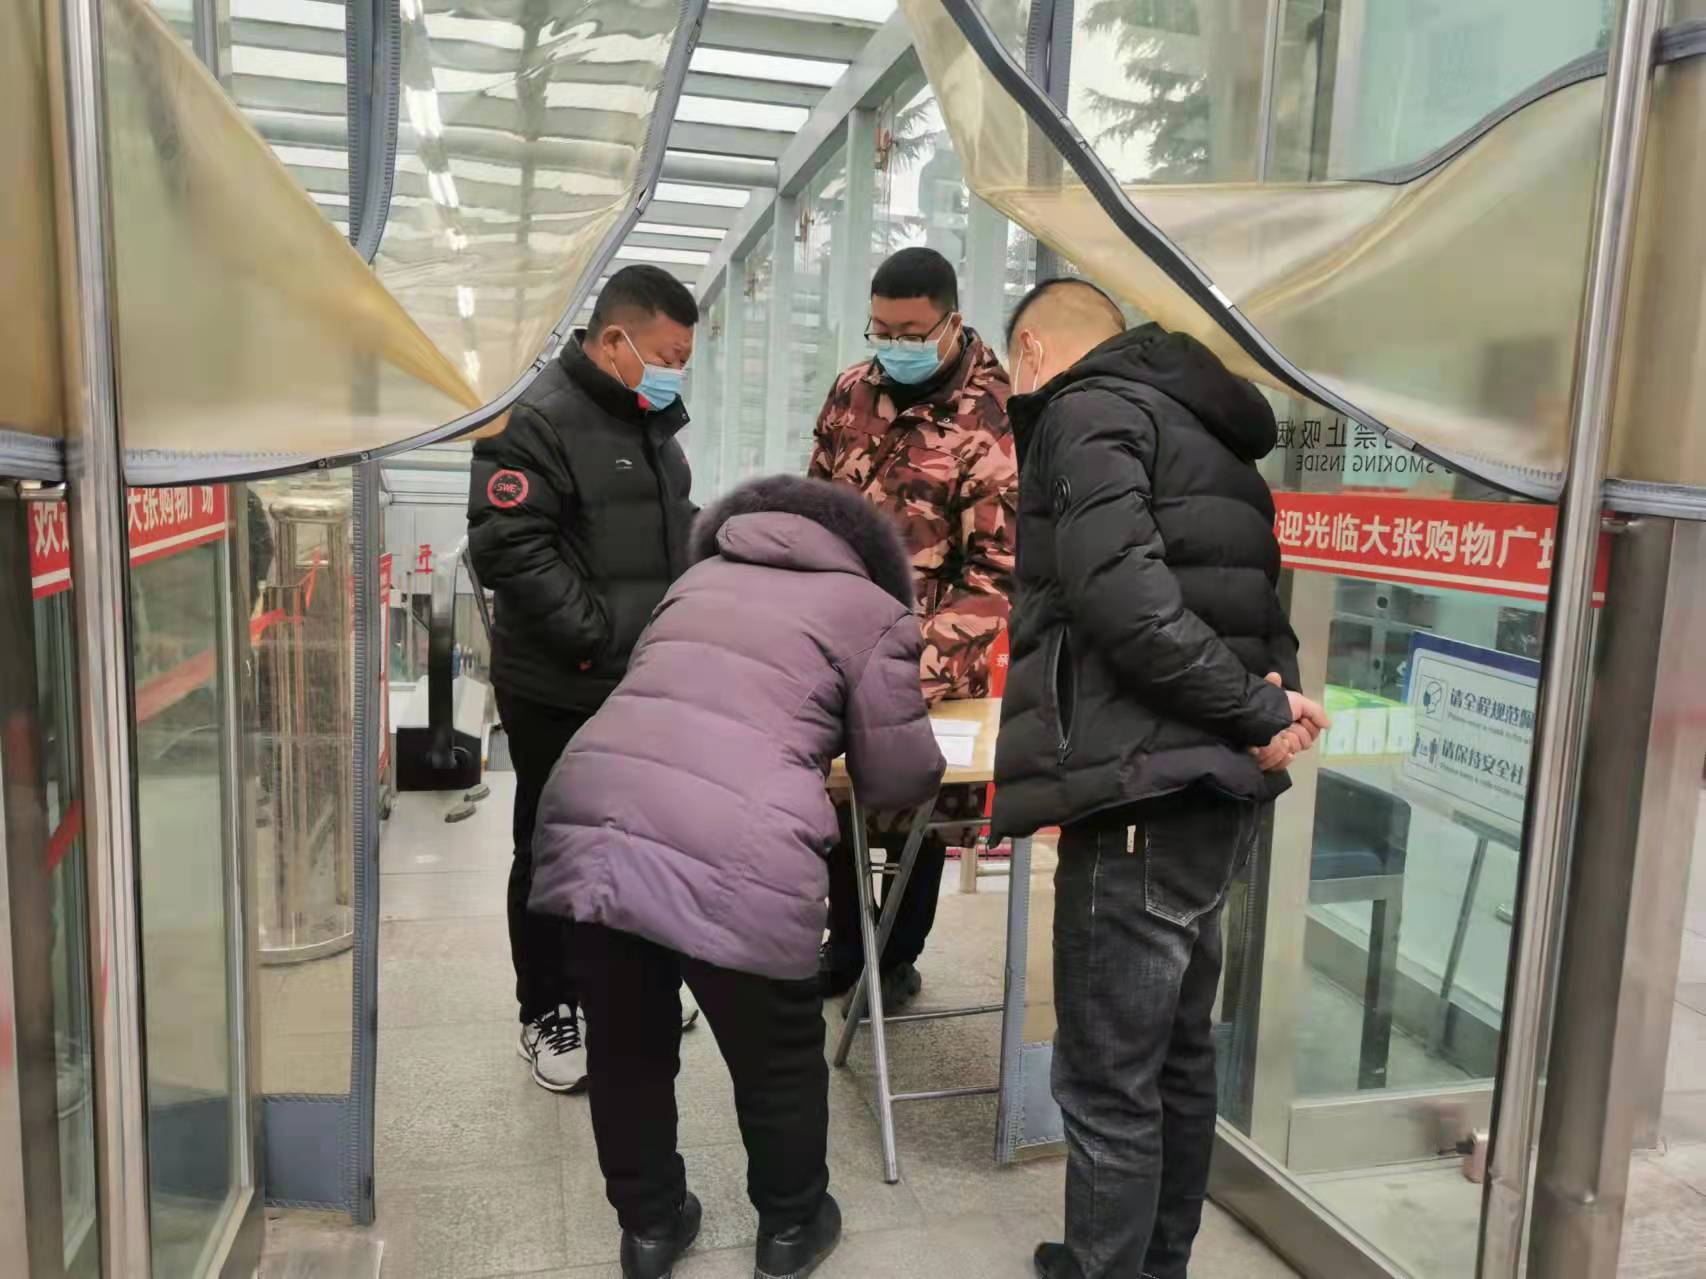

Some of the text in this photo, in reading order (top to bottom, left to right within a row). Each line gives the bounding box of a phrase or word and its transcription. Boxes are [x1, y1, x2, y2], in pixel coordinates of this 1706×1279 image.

[1275, 507, 1552, 569] 迎光临大张购物广
